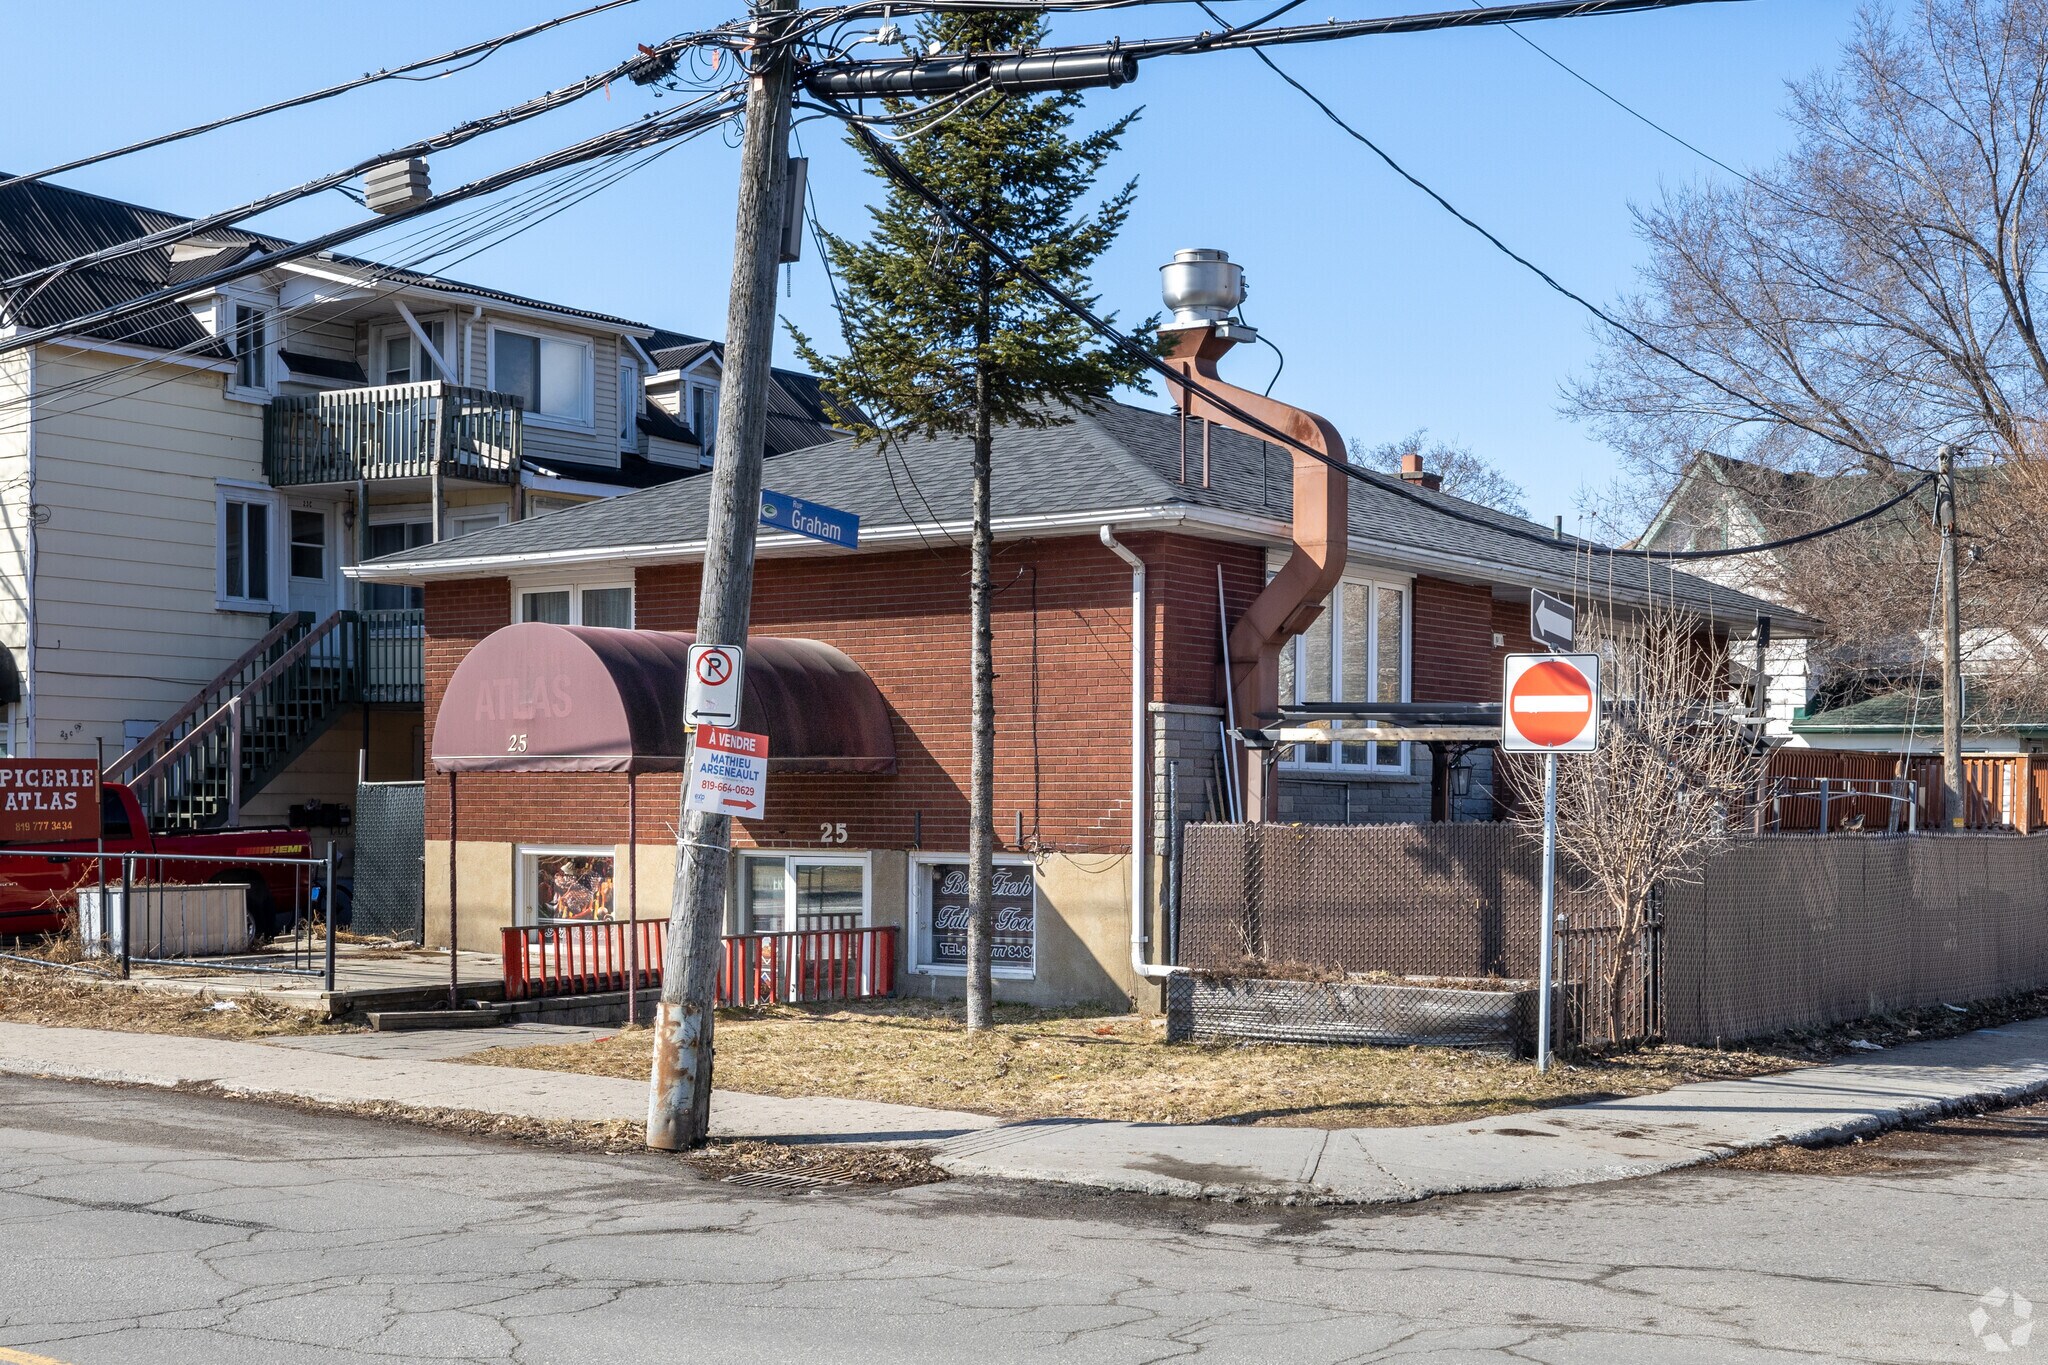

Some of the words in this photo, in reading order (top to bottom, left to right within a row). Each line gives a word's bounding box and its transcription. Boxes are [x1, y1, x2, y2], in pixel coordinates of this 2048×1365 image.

[792, 500, 803, 509] Rue
[791, 509, 841, 541] Graham
[707, 657, 722, 677] P
[474, 674, 573, 722] ATLAS
[508, 734, 527, 752] 25
[708, 728, 716, 745] À
[719, 732, 756, 752] VENDRE
[710, 753, 751, 769] MATHIEU
[700, 763, 759, 781] ARSENEAULT
[701, 779, 755, 796] 819-664-0629
[5, 791, 78, 811] ATLAS
[15, 822, 30, 831] 819
[33, 822, 49, 831] 777
[51, 821, 73, 830] 3434
[820, 822, 848, 843] 25
[270, 844, 303, 854] HEMI
[941, 870, 970, 895] Be
[991, 871, 1032, 896] Fresh
[1008, 946, 1022, 958] 34
